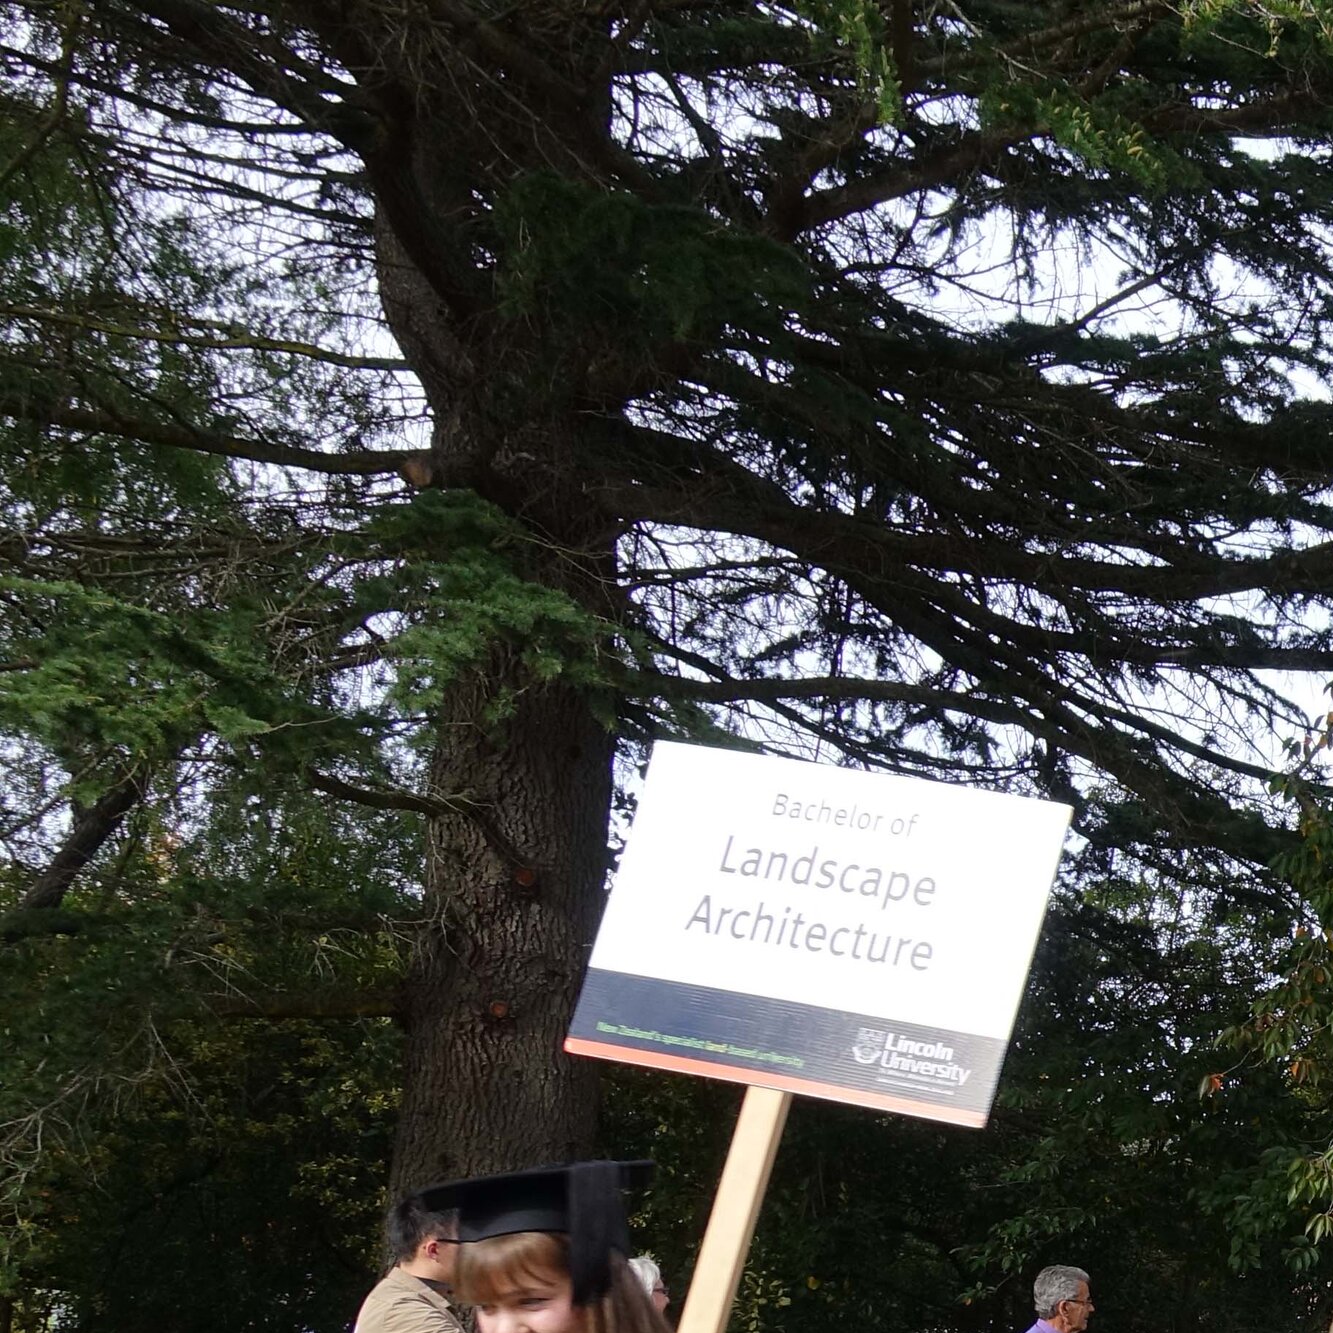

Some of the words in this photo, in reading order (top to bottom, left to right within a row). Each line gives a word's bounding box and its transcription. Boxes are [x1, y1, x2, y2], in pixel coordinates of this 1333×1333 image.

[772, 793, 883, 831] Bachelor
[890, 814, 920, 837] of
[719, 835, 936, 910] Landscape
[684, 894, 933, 970] Architecture
[880, 1050, 972, 1086] University
[884, 1032, 954, 1061] Lincoln
